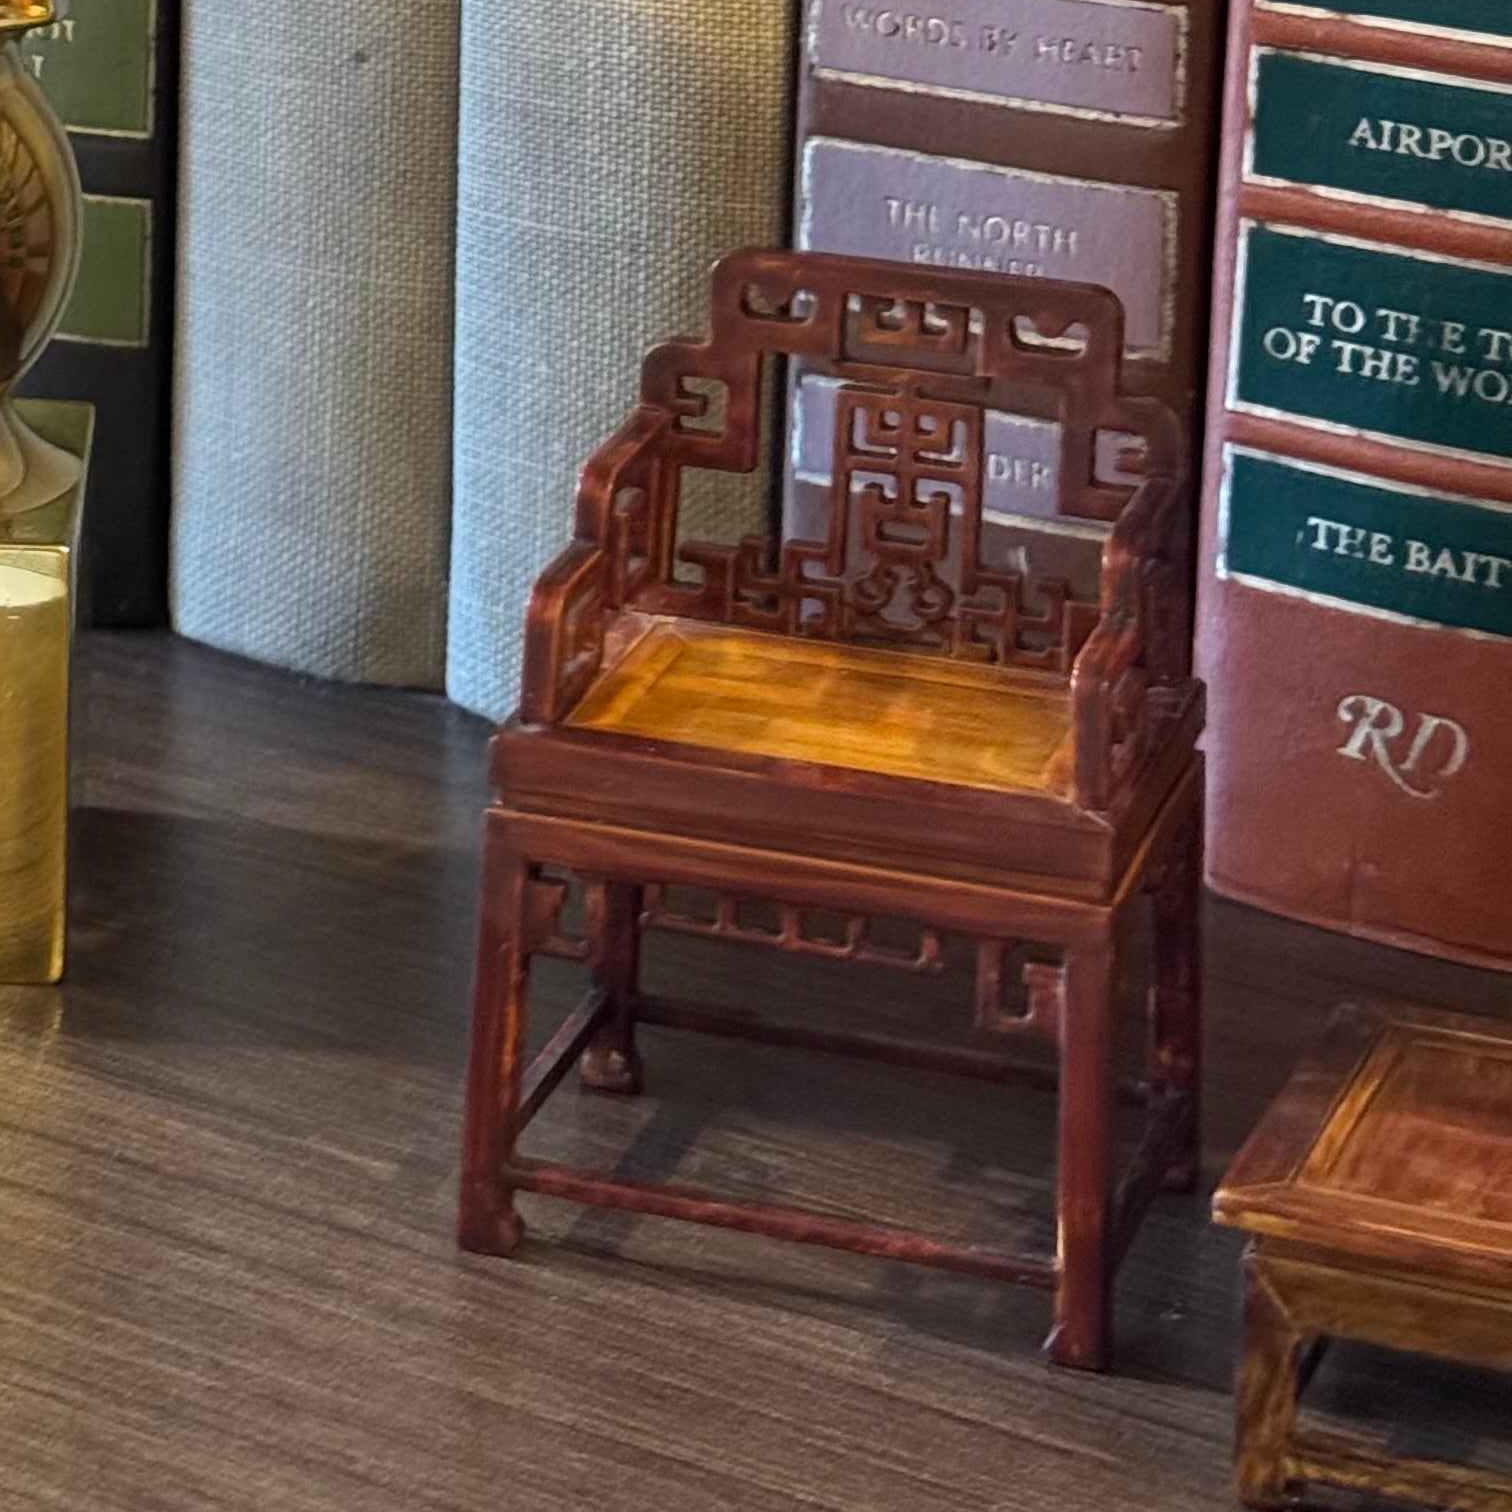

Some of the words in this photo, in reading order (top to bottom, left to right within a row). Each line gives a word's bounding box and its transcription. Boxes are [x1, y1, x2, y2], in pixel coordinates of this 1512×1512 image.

[845, 4, 968, 49] WORDS
[979, 26, 1017, 53] BY
[1034, 37, 1143, 72] HEART
[885, 199, 938, 232] THE
[957, 215, 1078, 254] NORTH
[1303, 293, 1364, 334] TO
[1263, 326, 1320, 365] OF
[1331, 339, 1420, 386] THE
[1307, 516, 1394, 566] THE
[1405, 540, 1512, 588] BAIT
[1336, 694, 1469, 800] RD
